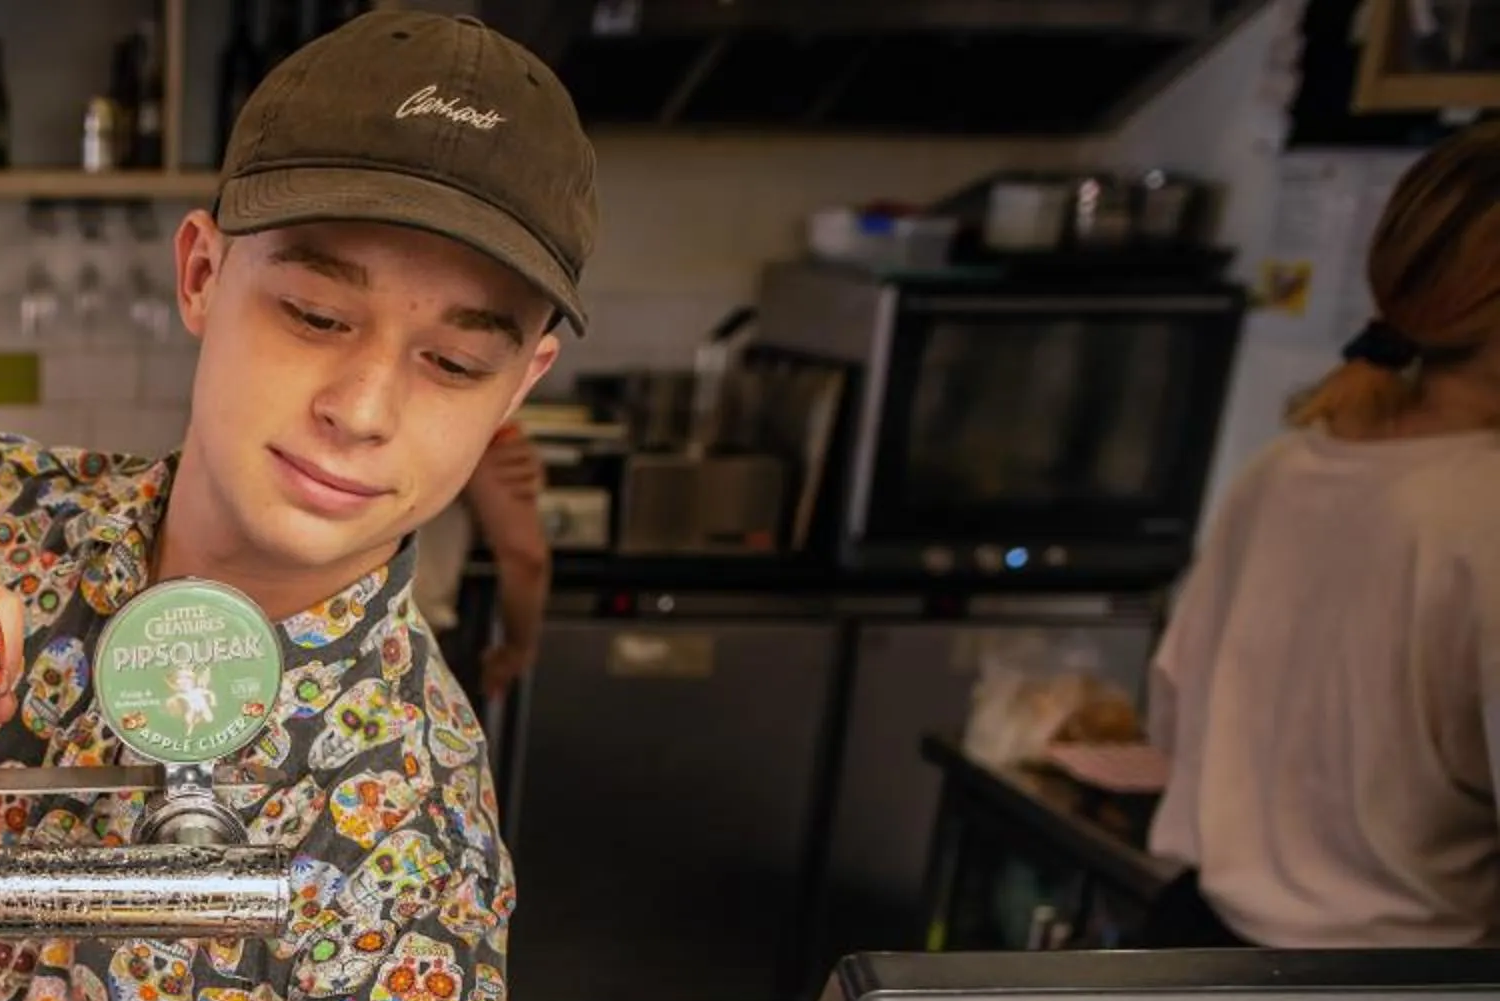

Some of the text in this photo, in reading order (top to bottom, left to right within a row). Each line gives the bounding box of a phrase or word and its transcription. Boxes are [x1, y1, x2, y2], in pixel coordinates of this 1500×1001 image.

[113, 633, 265, 672] PIPSQUEAK
[140, 717, 247, 752] APPLE CIDER
